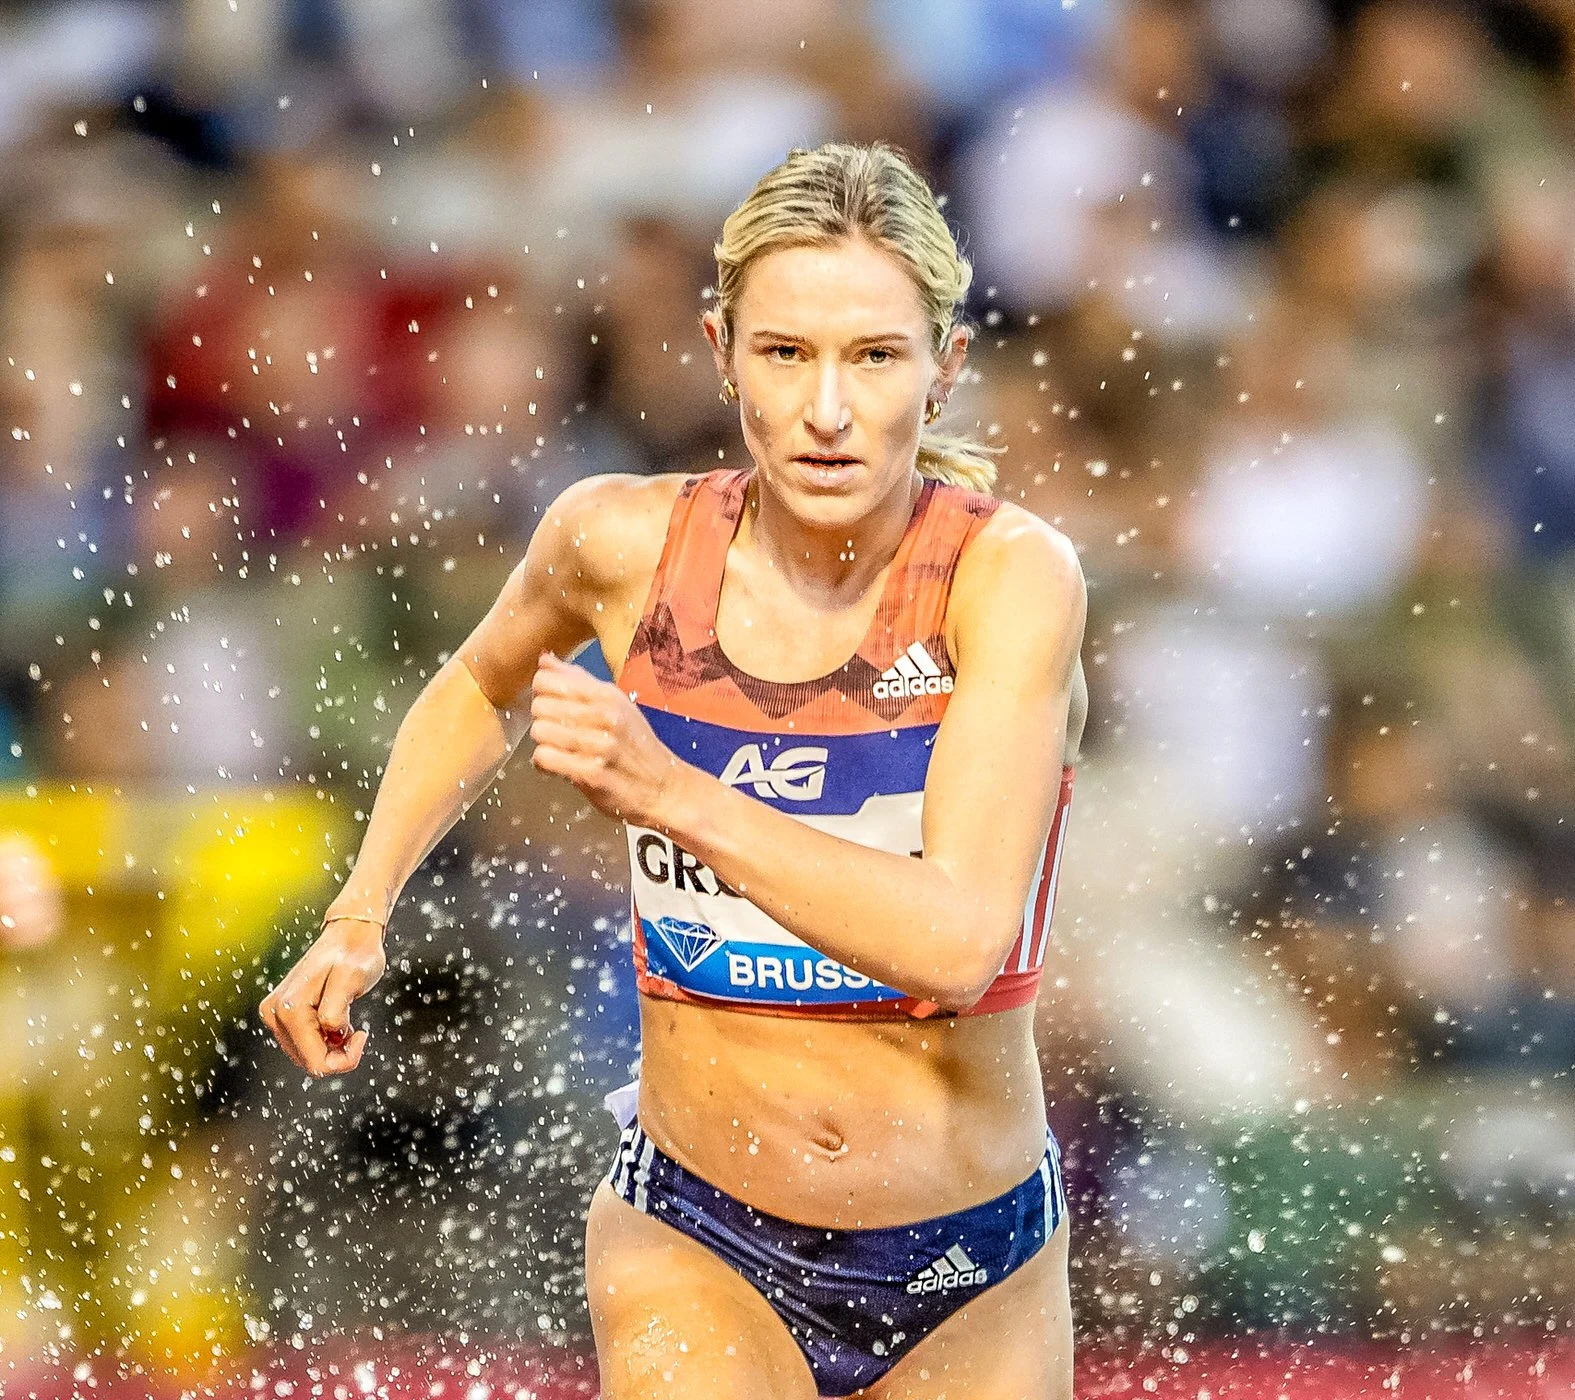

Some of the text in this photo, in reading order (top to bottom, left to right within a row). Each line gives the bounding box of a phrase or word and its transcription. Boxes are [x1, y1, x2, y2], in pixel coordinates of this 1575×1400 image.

[872, 675, 954, 700] adidas
[719, 743, 829, 801] AG
[728, 953, 886, 990] BRUSS
[906, 1268, 988, 1295] adidas
